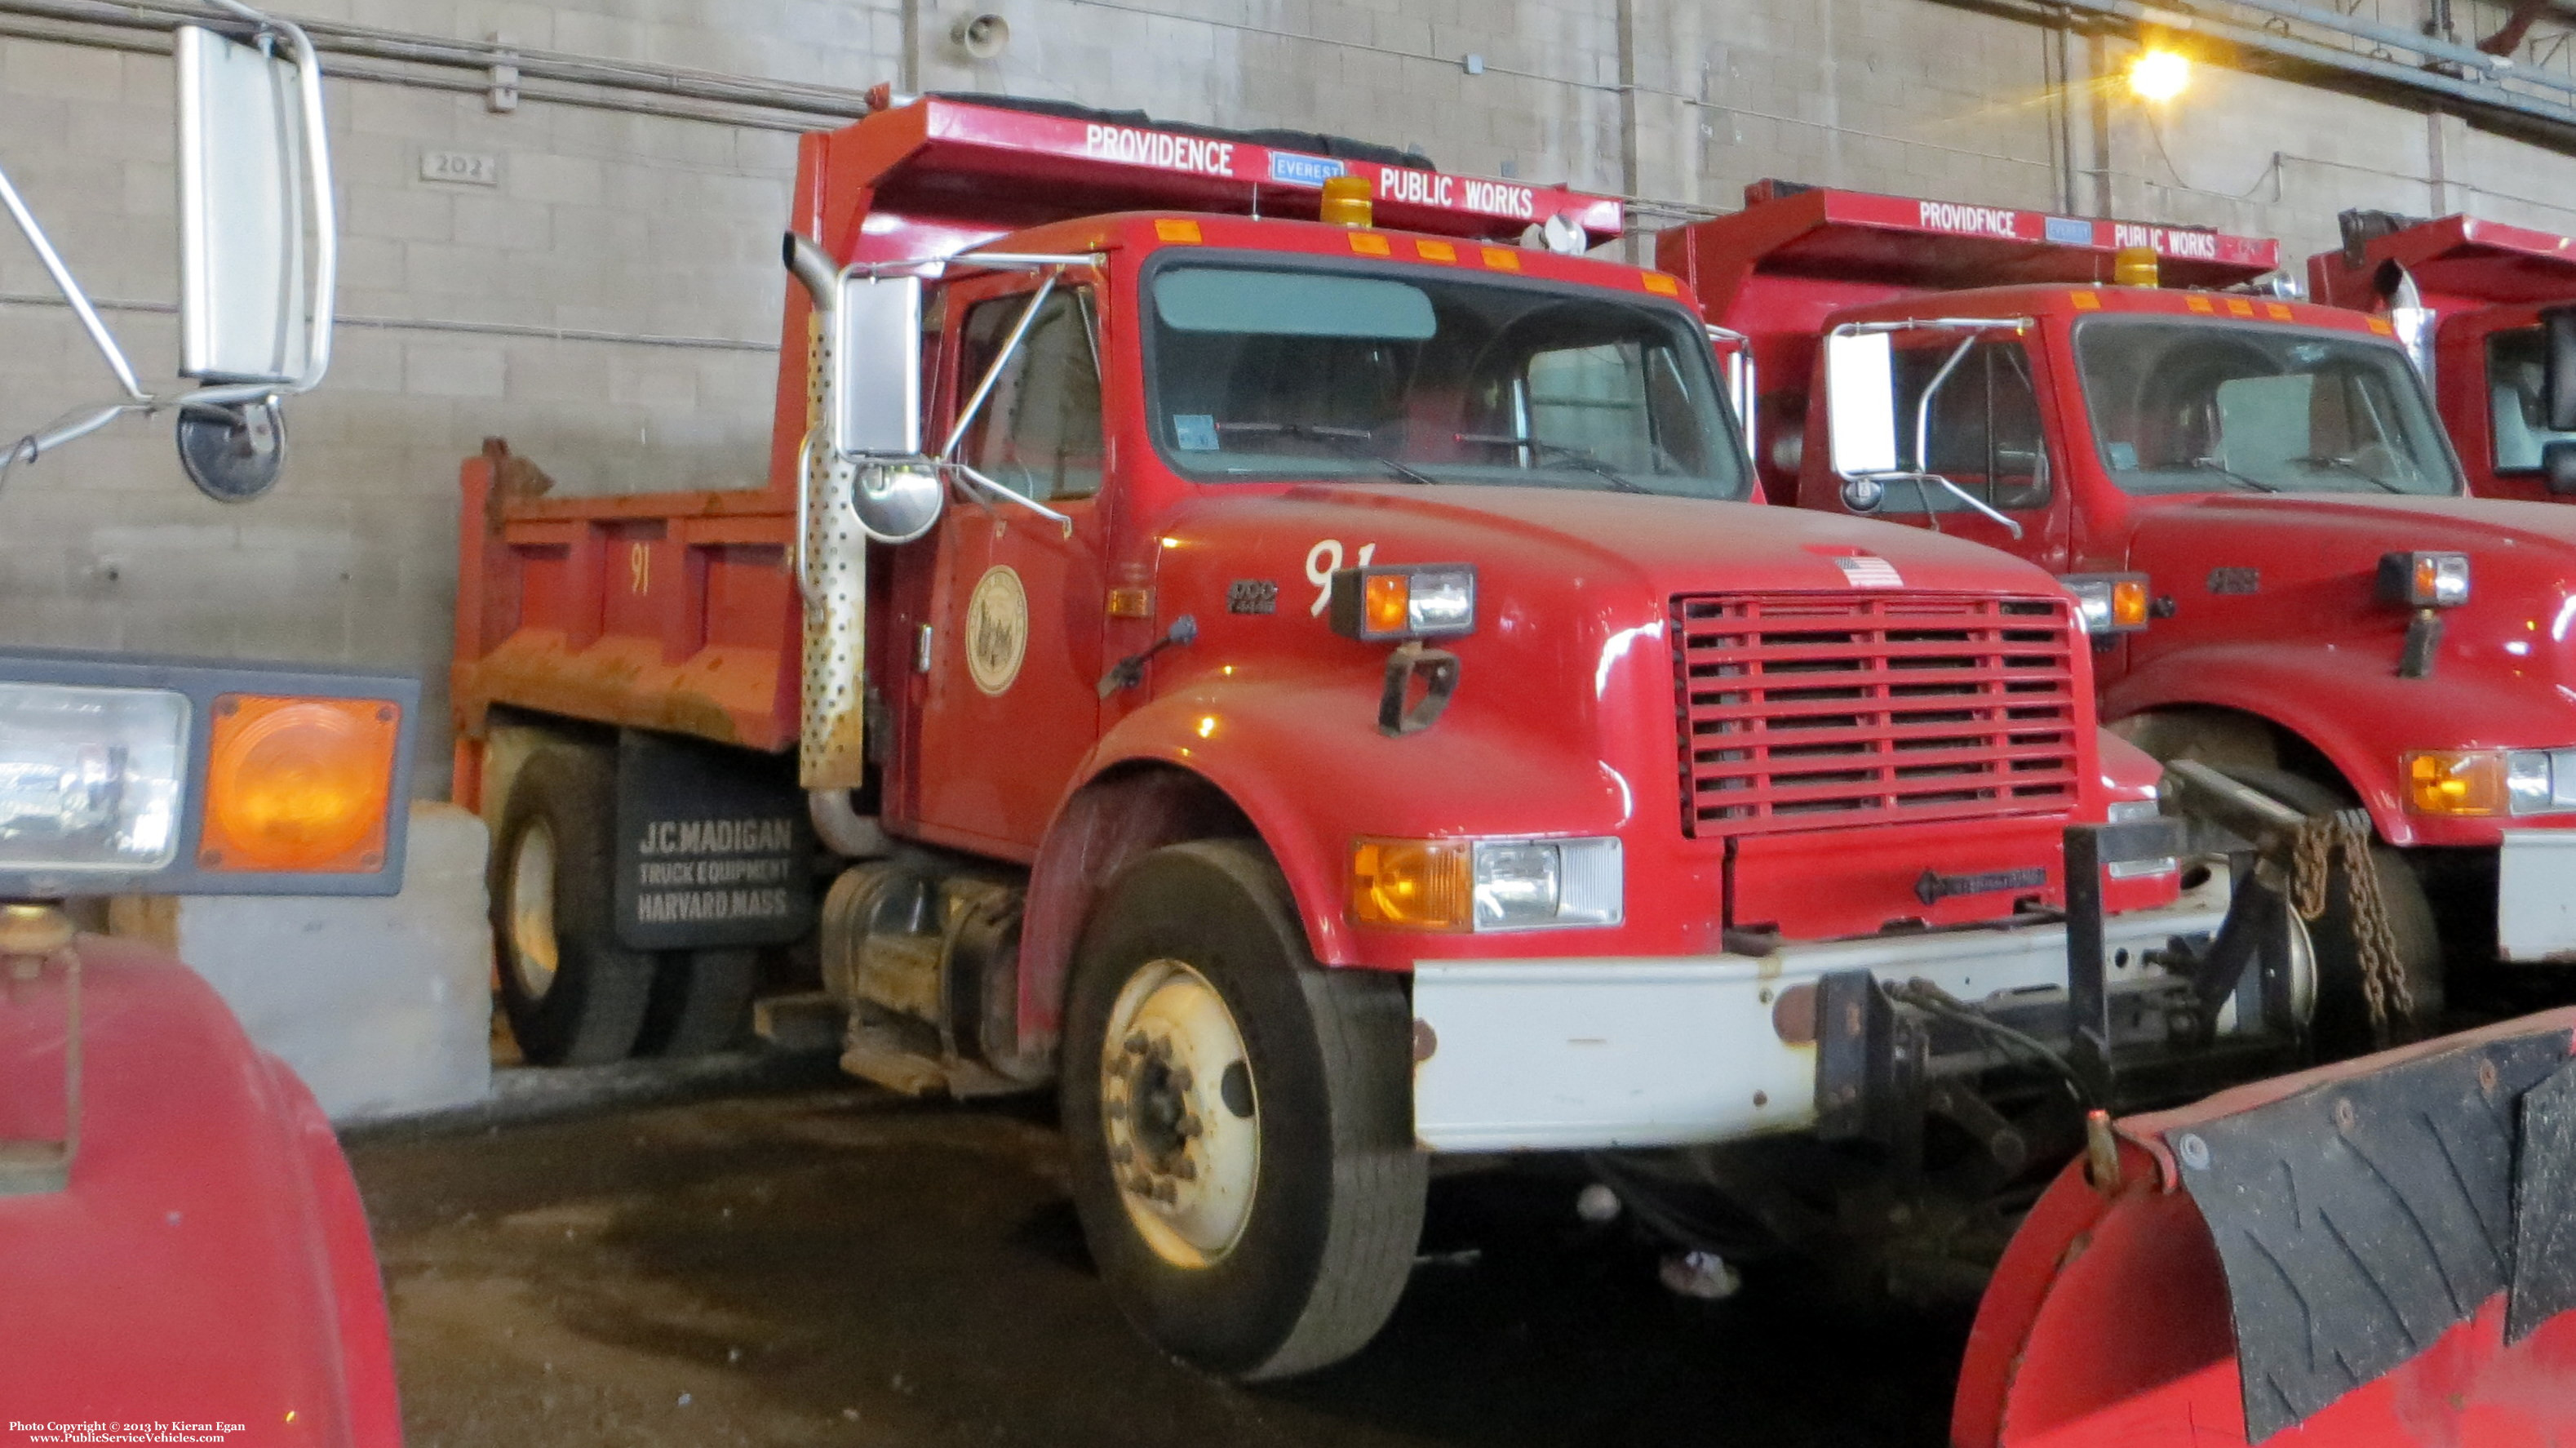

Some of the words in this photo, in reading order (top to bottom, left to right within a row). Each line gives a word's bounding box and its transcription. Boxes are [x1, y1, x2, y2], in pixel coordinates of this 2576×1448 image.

[1086, 124, 1234, 177] PROVIDENCE
[1381, 167, 1452, 207] PUBLIC
[1465, 180, 1533, 218] WORKS
[1276, 158, 1340, 179] EVEREST
[2168, 230, 2215, 258] WORKS
[632, 542, 650, 597] 91
[681, 819, 792, 852] MADIGAN
[639, 861, 694, 885] TRUCK
[638, 891, 729, 922] HARVARD
